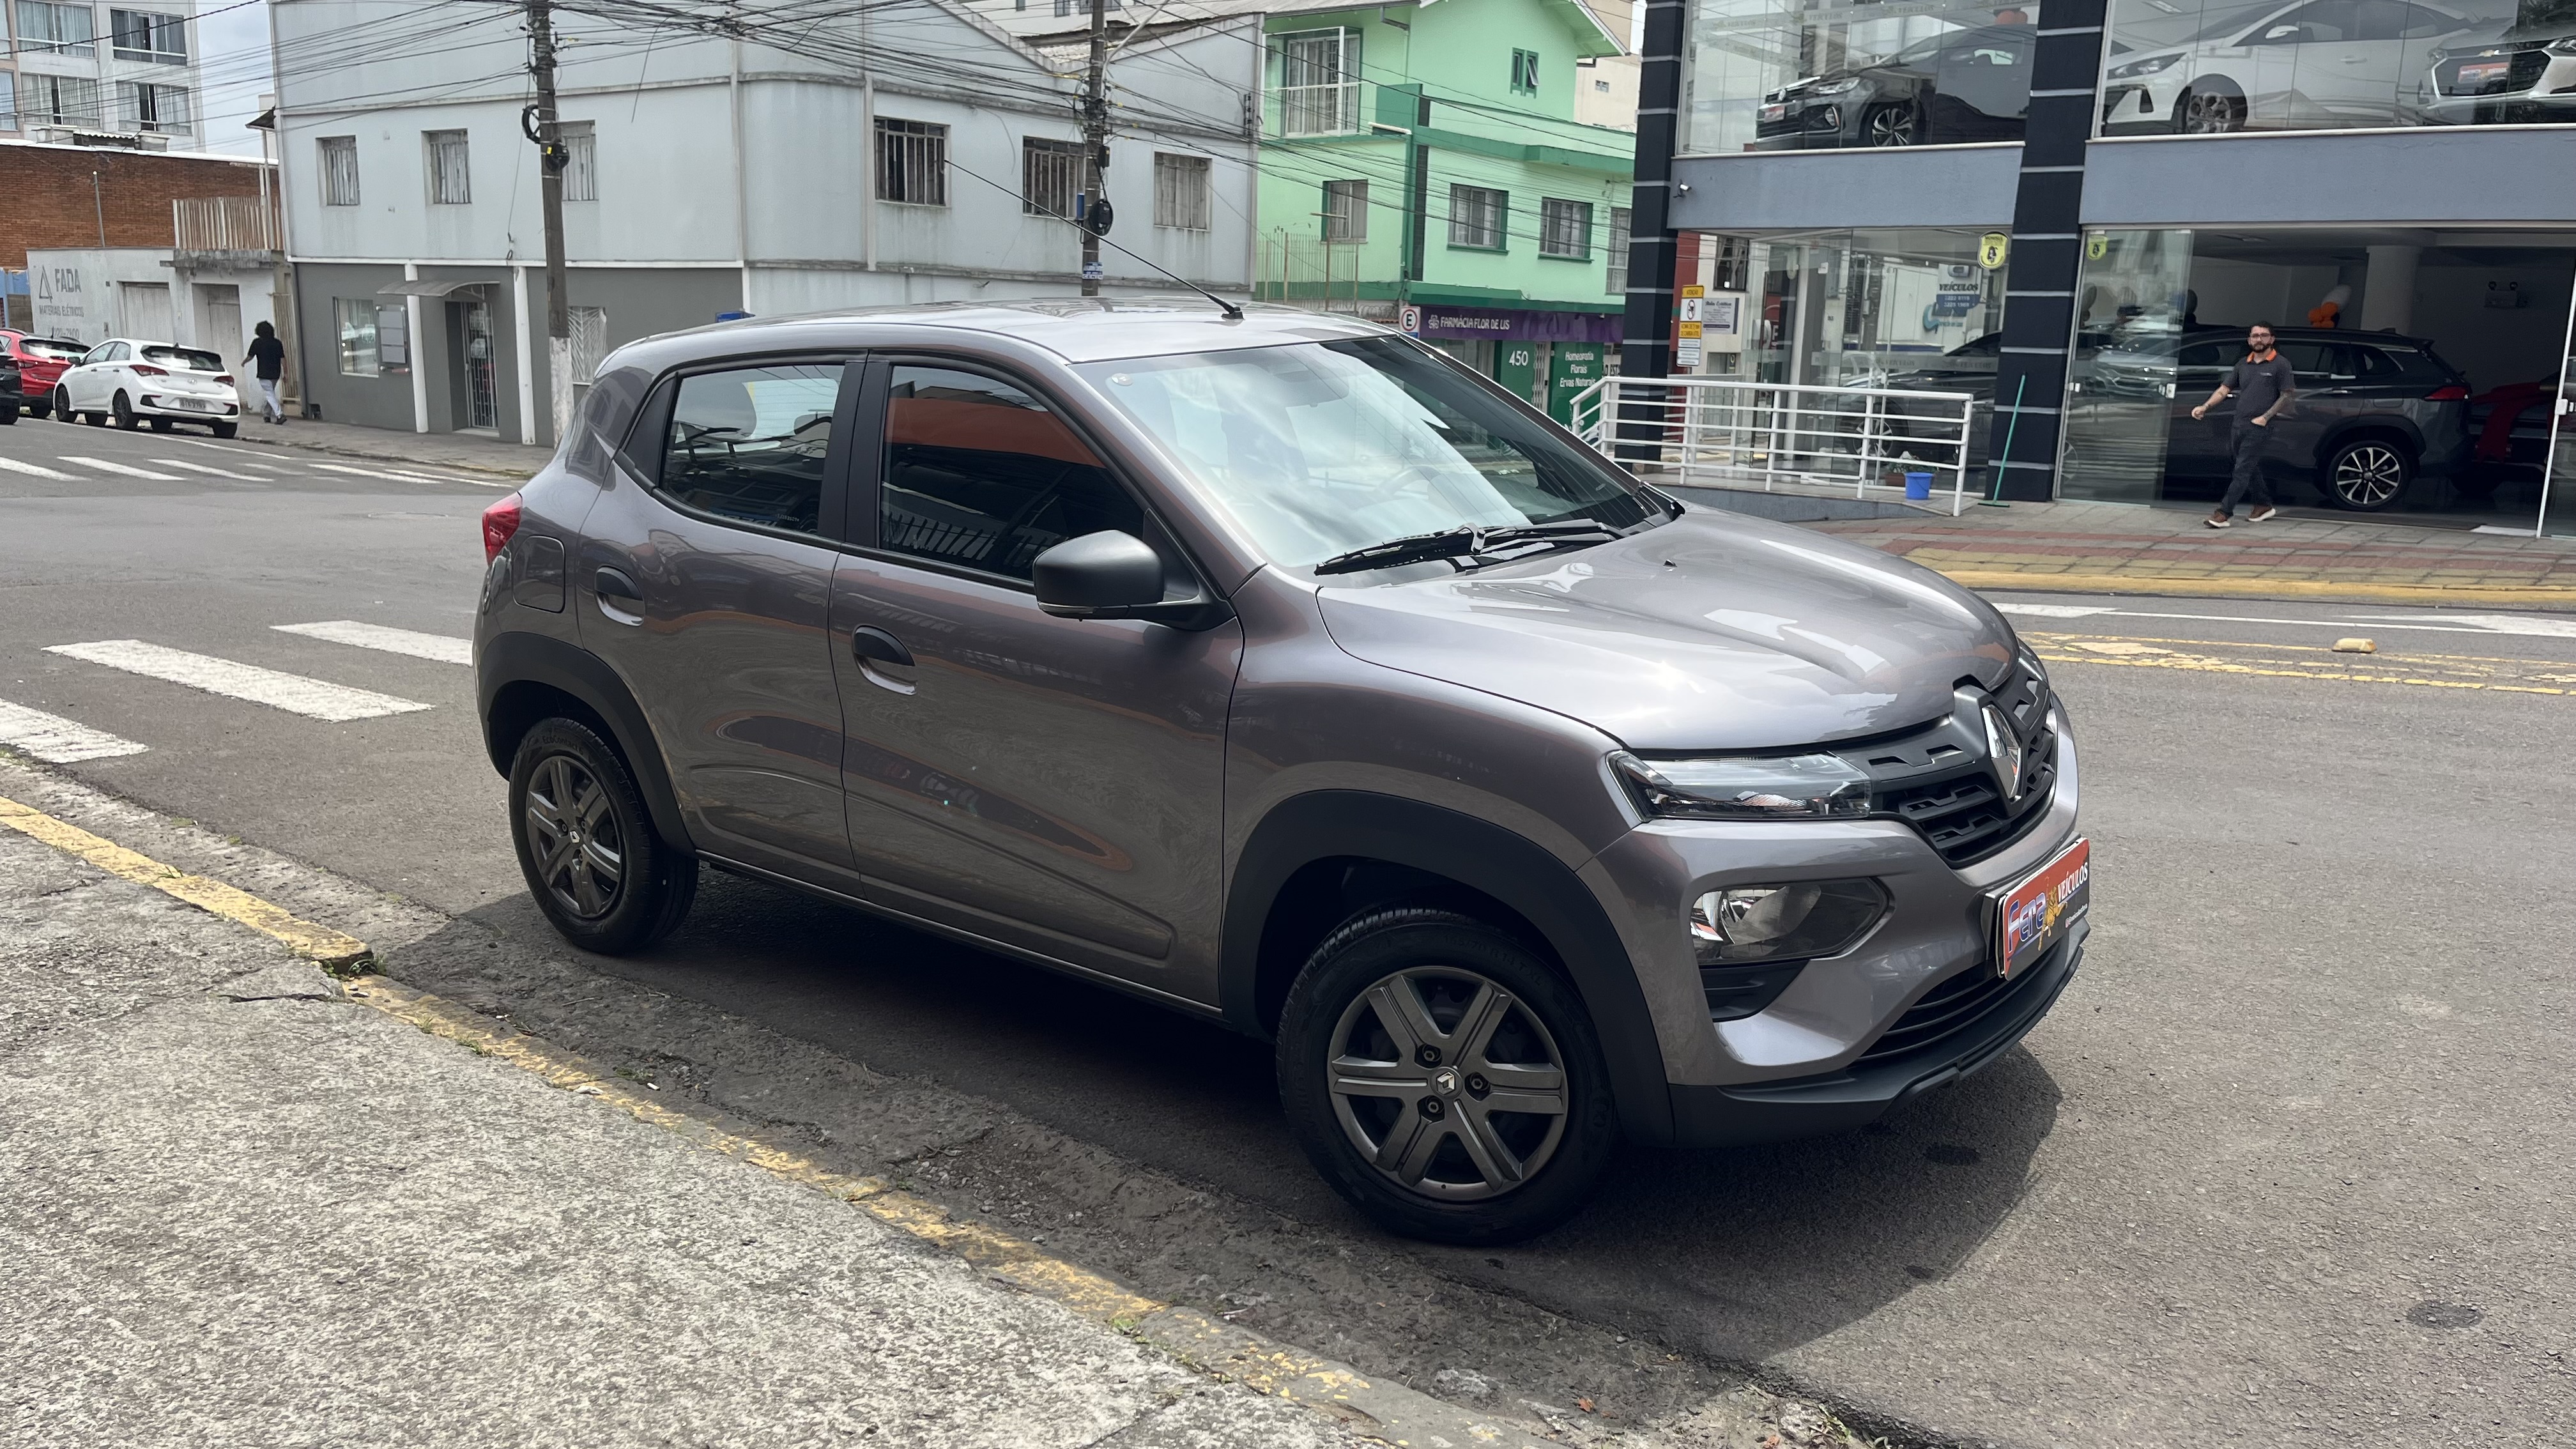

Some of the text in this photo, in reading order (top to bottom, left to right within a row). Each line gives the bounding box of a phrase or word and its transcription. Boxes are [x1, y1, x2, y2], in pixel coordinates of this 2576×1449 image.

[54, 268, 82, 293] FADA
[1939, 281, 1979, 291] VEÍCULOS
[39, 303, 84, 317] MATERIAIS ELÉTRICOS
[1406, 314, 1413, 327] E
[1440, 314, 1510, 330] FARMÁCIA FLOR DE LIS
[1508, 350, 1529, 366] 450
[1565, 351, 1594, 361] Homeopatia
[1570, 364, 1588, 374] Florais
[1560, 377, 1596, 387] Ervas Naturais
[2057, 862, 2088, 902] VEÍCULOS
[2007, 892, 2047, 954] Fera
